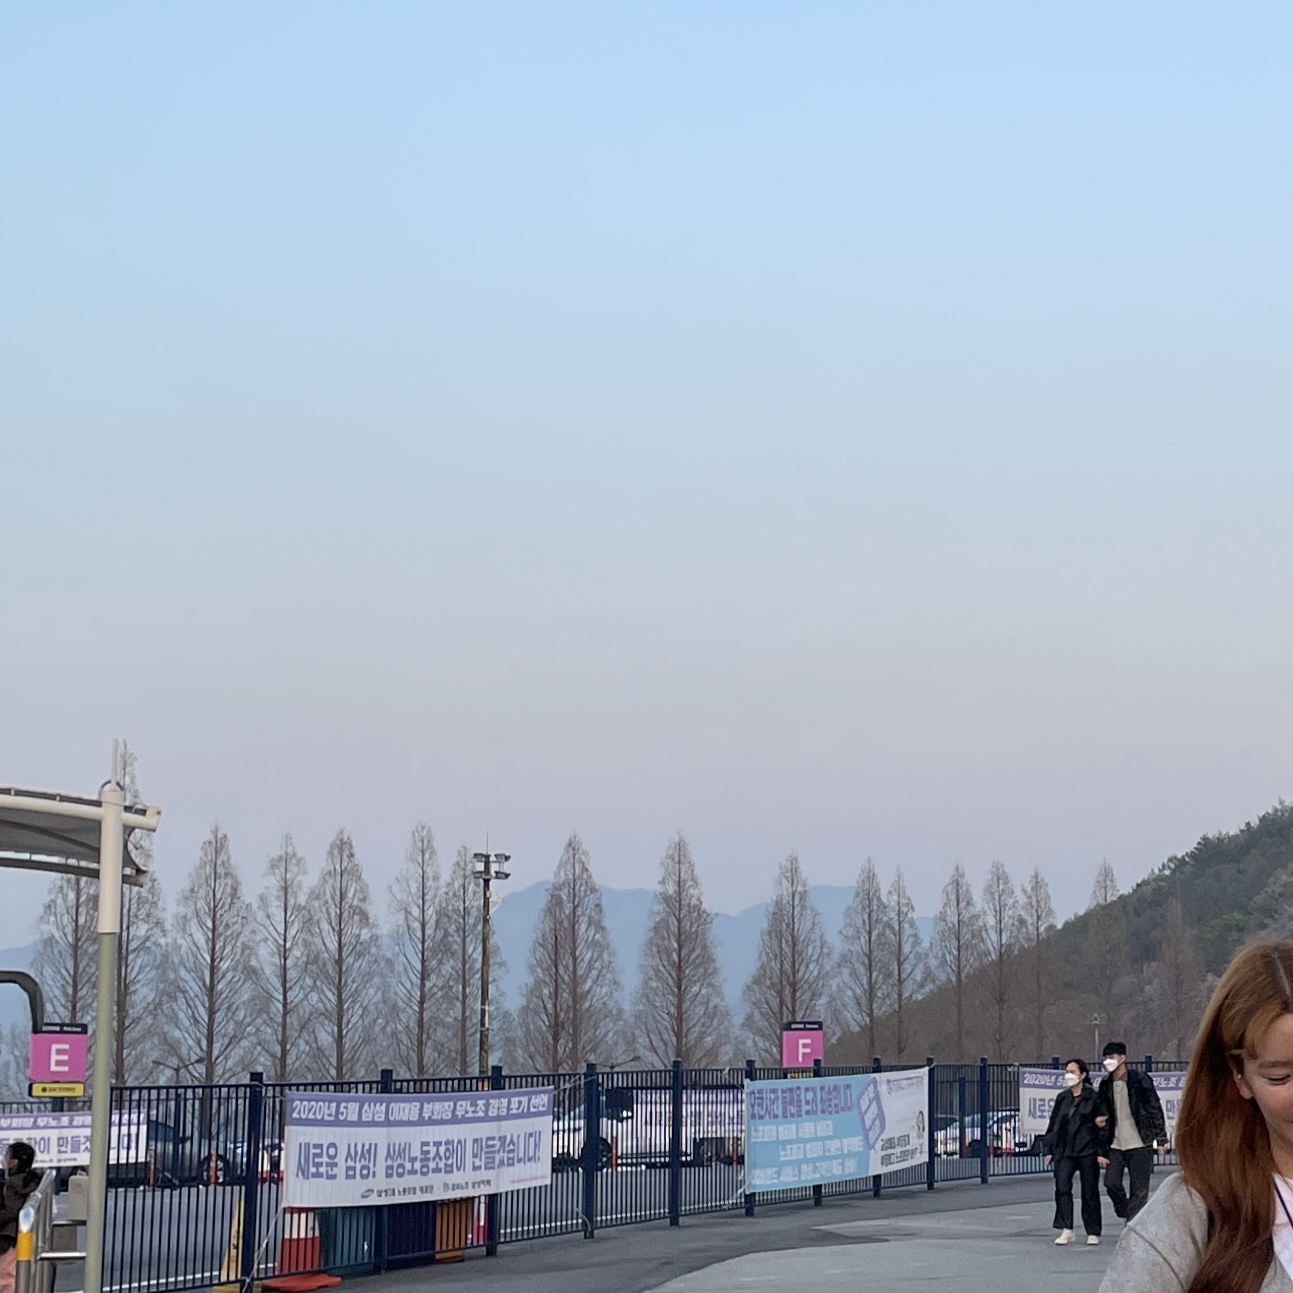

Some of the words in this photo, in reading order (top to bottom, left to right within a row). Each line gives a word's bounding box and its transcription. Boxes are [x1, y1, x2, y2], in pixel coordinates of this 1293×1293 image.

[50, 1043, 70, 1072] E
[798, 1038, 812, 1063] F
[1023, 1073, 1056, 1086] 2020년
[292, 1101, 336, 1120] 2020년
[339, 1102, 359, 1121] 5월
[361, 1102, 386, 1121] 삼성
[388, 1102, 420, 1121] 이재용
[422, 1101, 454, 1120] 부회장
[455, 1099, 486, 1118] 무노조
[488, 1097, 508, 1116] 경영
[509, 1095, 528, 1115] 포기
[529, 1093, 548, 1112] 선언
[37, 1115, 70, 1127] 무노조
[296, 1142, 338, 1180] 새로운
[345, 1142, 378, 1180] 삼성!
[385, 1138, 467, 1178] 삼성노동조합이
[472, 1130, 541, 1172] 만들겠습니다!
